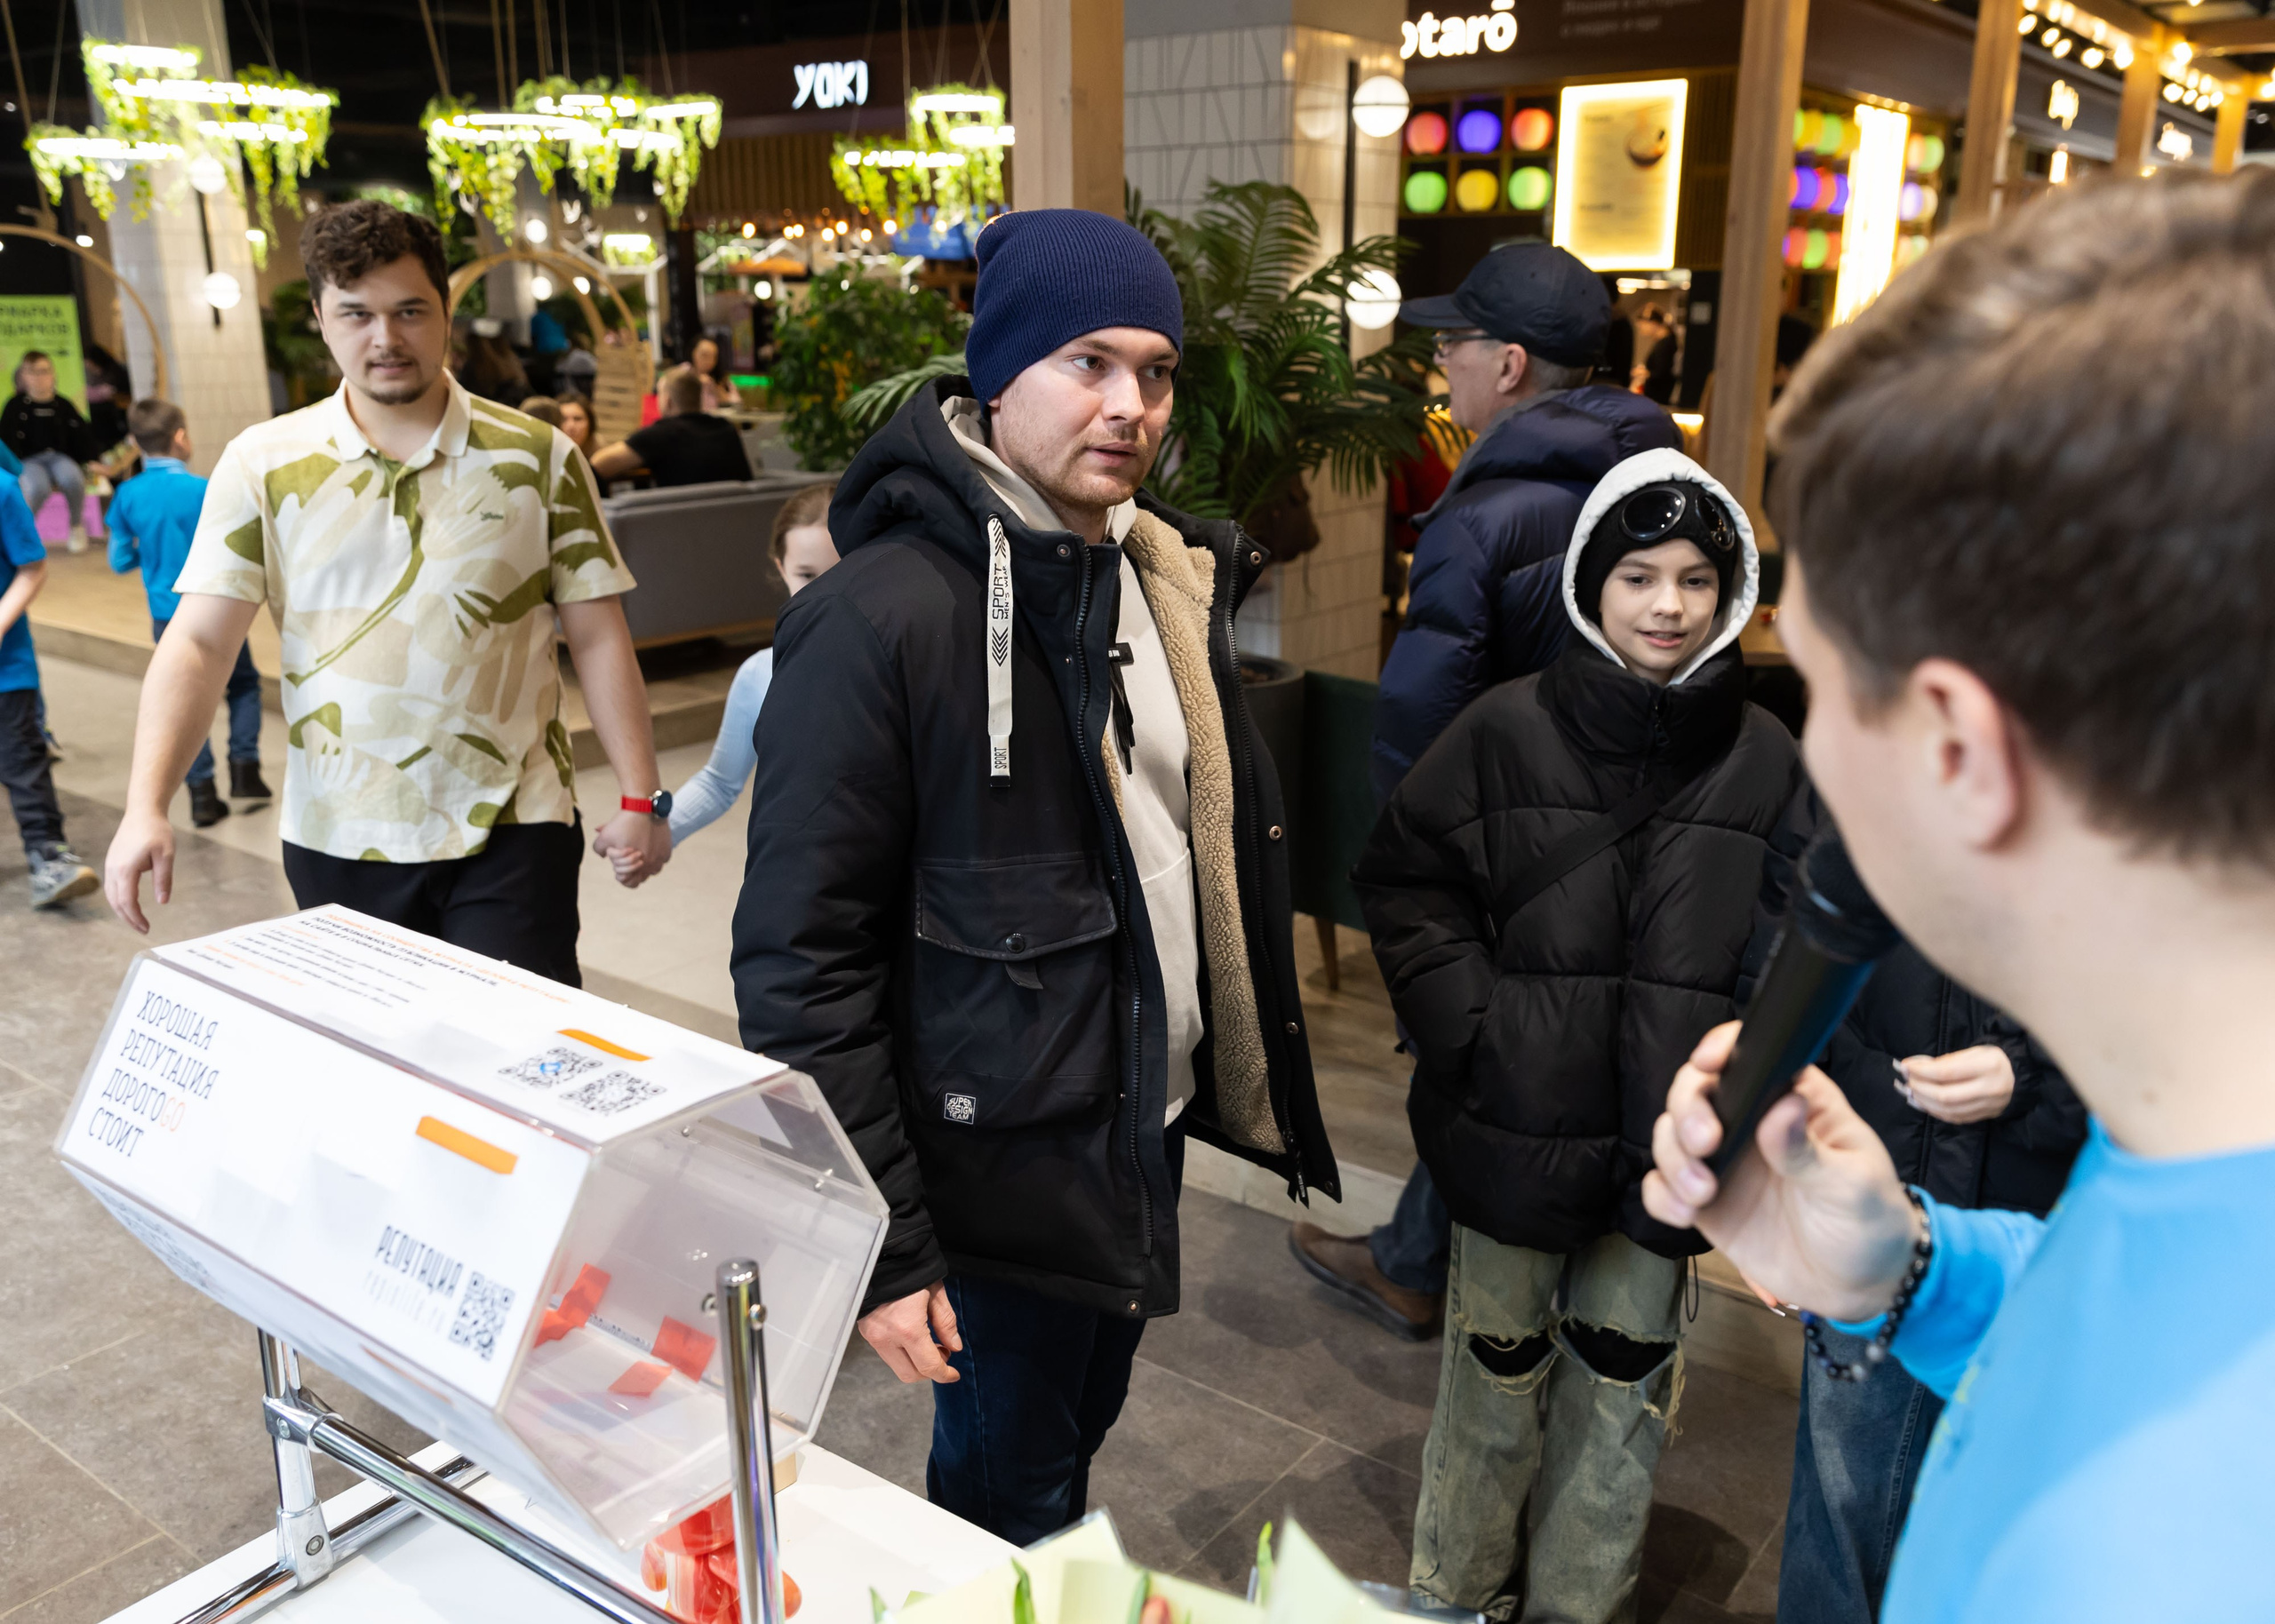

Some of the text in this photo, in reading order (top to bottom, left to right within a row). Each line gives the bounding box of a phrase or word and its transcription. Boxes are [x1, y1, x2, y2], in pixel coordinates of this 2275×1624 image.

[792, 60, 868, 109] YOKI
[993, 563, 1004, 619] SPORT
[994, 747, 1007, 769] SPORT
[137, 991, 219, 1050] ХОРОШАЯ
[120, 1029, 220, 1100] РЕПУТАЦИЯ
[947, 1103, 973, 1115] DESIGN
[949, 1097, 972, 1107] SUPER
[949, 1111, 970, 1120] TEAM
[89, 1107, 144, 1158] СТОИТ
[375, 1225, 464, 1299] РЕПУТАЦИЯ
